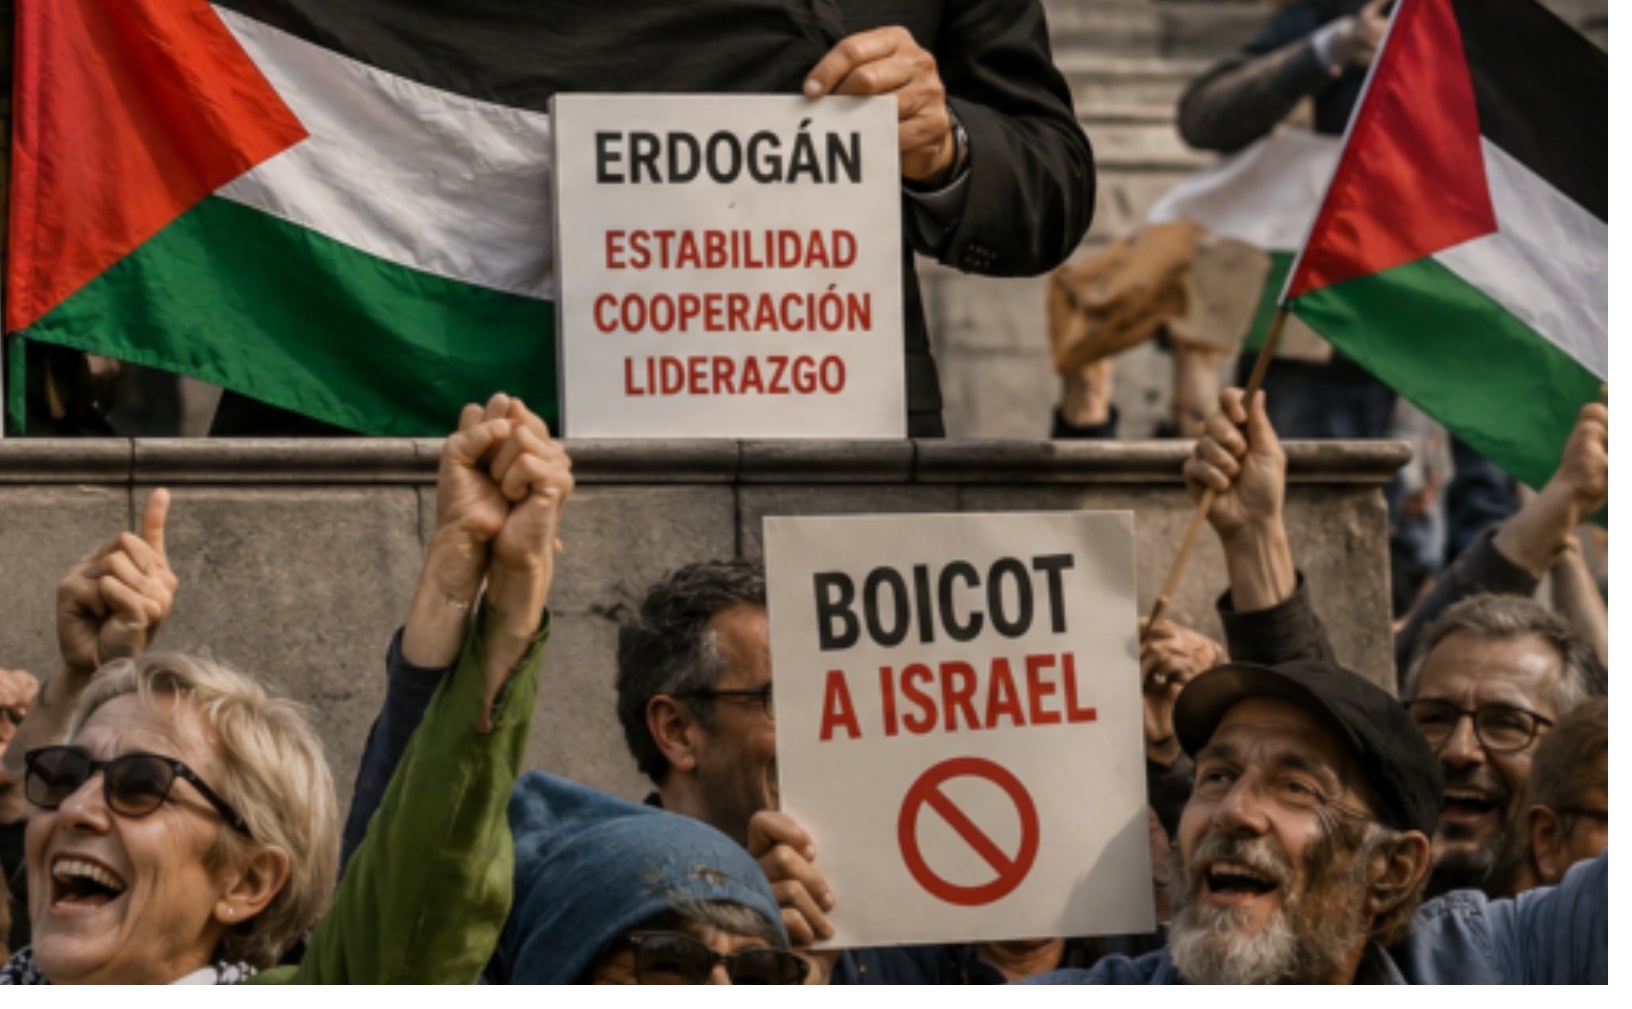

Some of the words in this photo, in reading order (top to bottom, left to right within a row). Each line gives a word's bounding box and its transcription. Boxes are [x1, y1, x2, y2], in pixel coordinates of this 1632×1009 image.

[595, 118, 861, 184] ERDOGÁN
[606, 230, 857, 269] ESTABILIDAD
[594, 284, 871, 333] COOPERACIÓN
[624, 355, 845, 396] LIDERAZGO
[814, 554, 1074, 651] BOICOT
[820, 670, 861, 741] A
[880, 653, 1096, 736] ISRAEL
